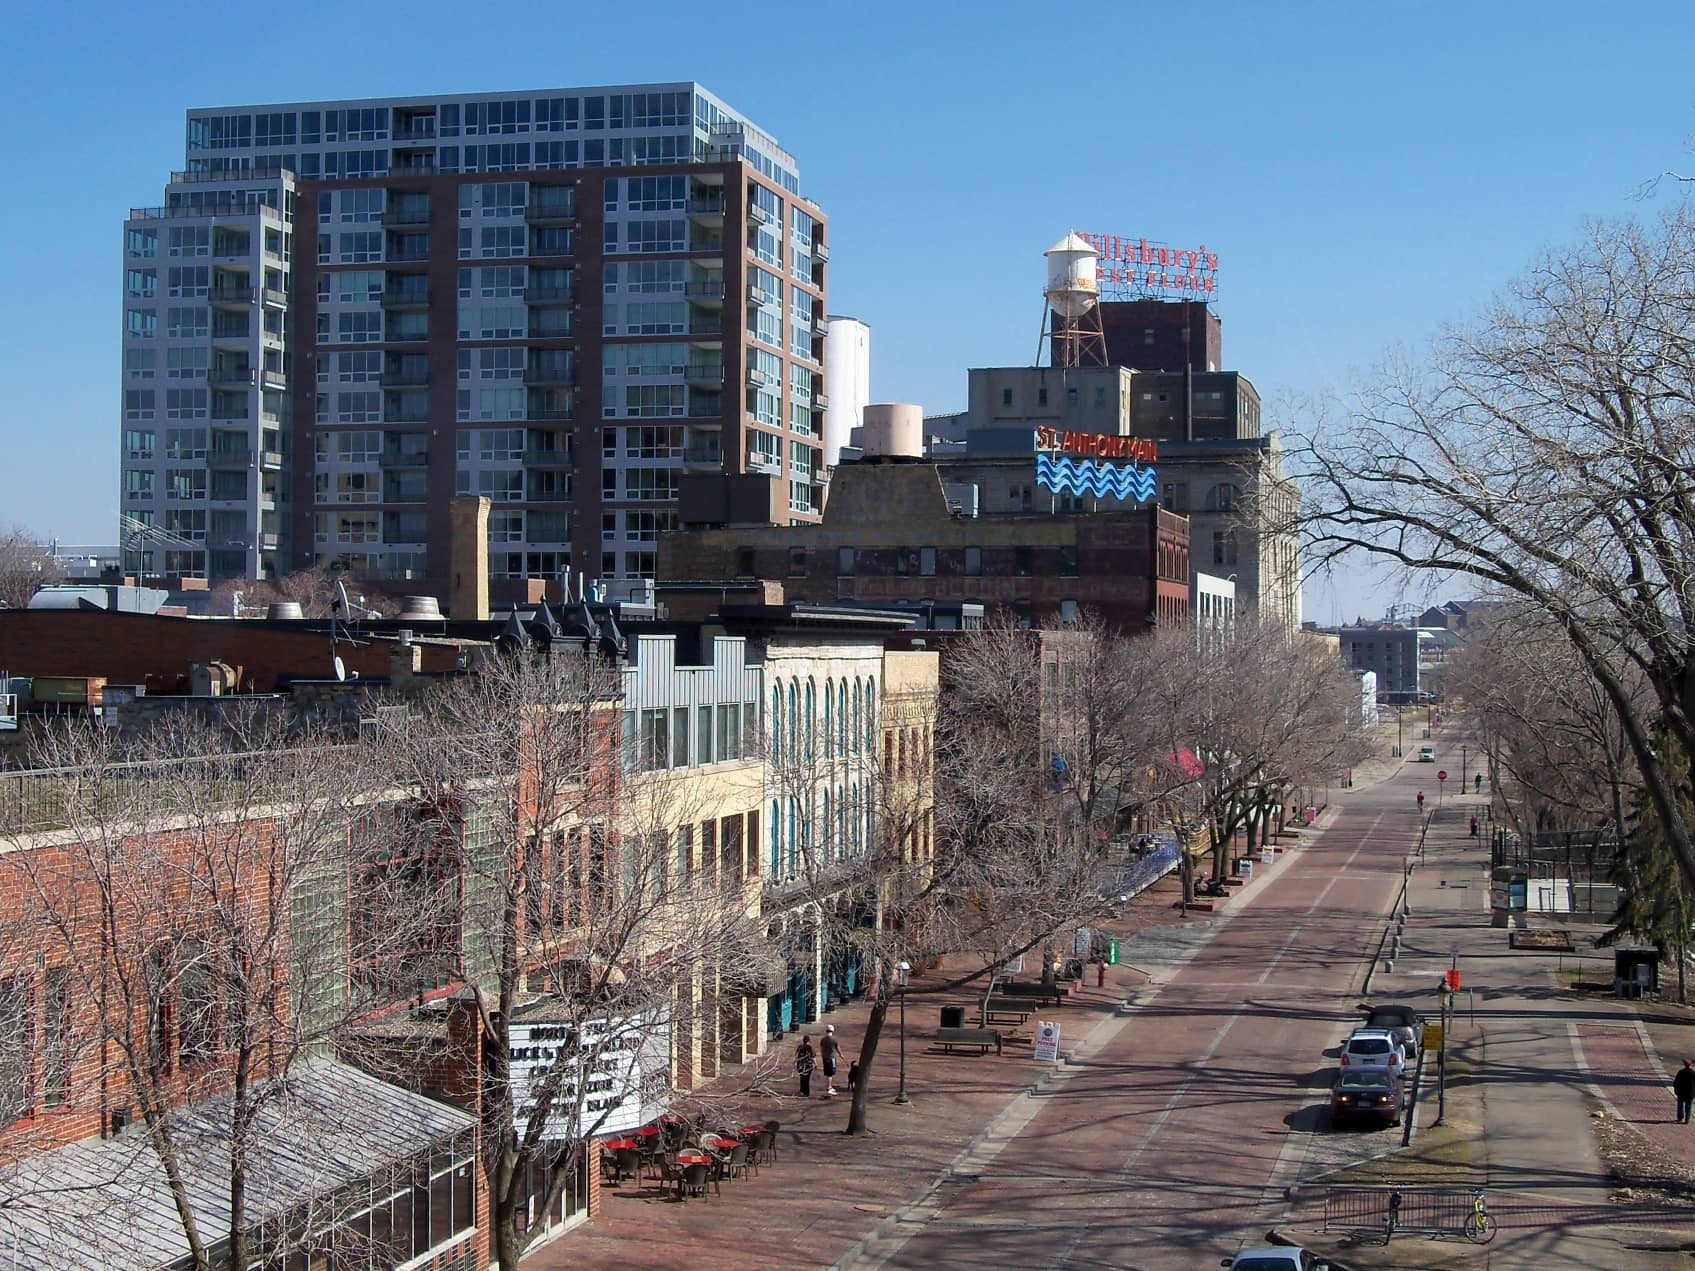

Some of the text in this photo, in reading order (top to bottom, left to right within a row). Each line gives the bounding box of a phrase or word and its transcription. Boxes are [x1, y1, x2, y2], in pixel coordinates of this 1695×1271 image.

[1096, 266, 1216, 293] EST FLOUR
[1062, 430, 1126, 458] ANTHONY
[1127, 437, 1158, 462] MAIN
